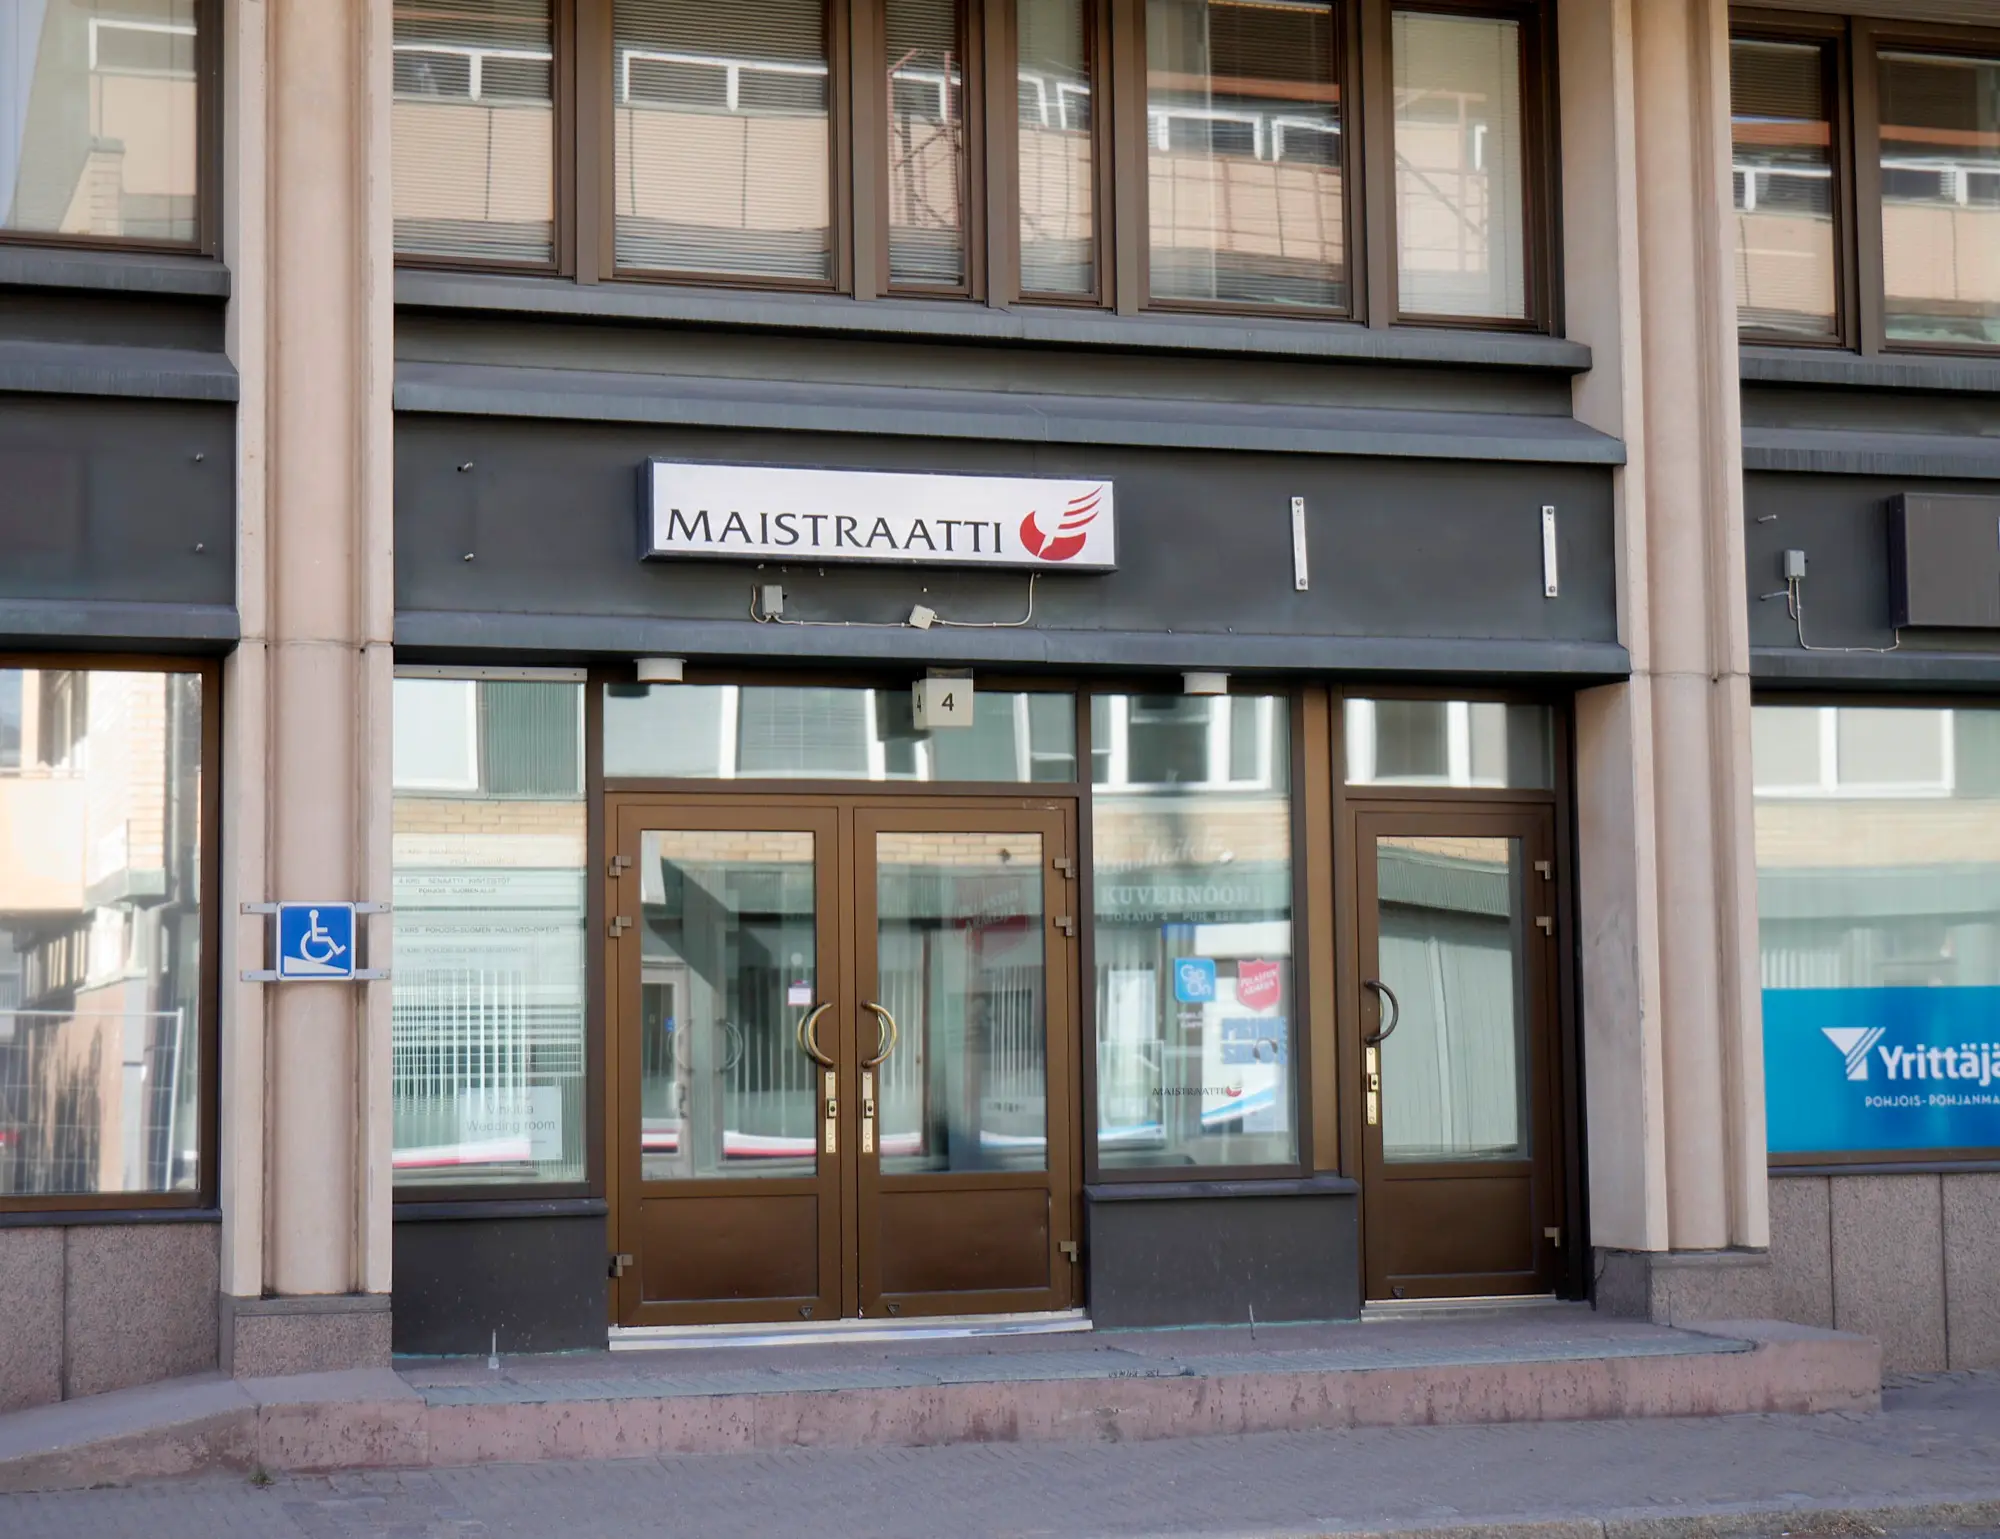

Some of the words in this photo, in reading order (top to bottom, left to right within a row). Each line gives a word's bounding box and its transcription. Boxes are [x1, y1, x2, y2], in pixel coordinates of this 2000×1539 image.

[666, 508, 1002, 553] MAISTRAATTI
[941, 692, 954, 712] 4
[1187, 981, 1212, 996] On
[1152, 1087, 1225, 1096] MAISTRAATTI
[467, 1120, 520, 1134] Wedding
[525, 1120, 555, 1130] room
